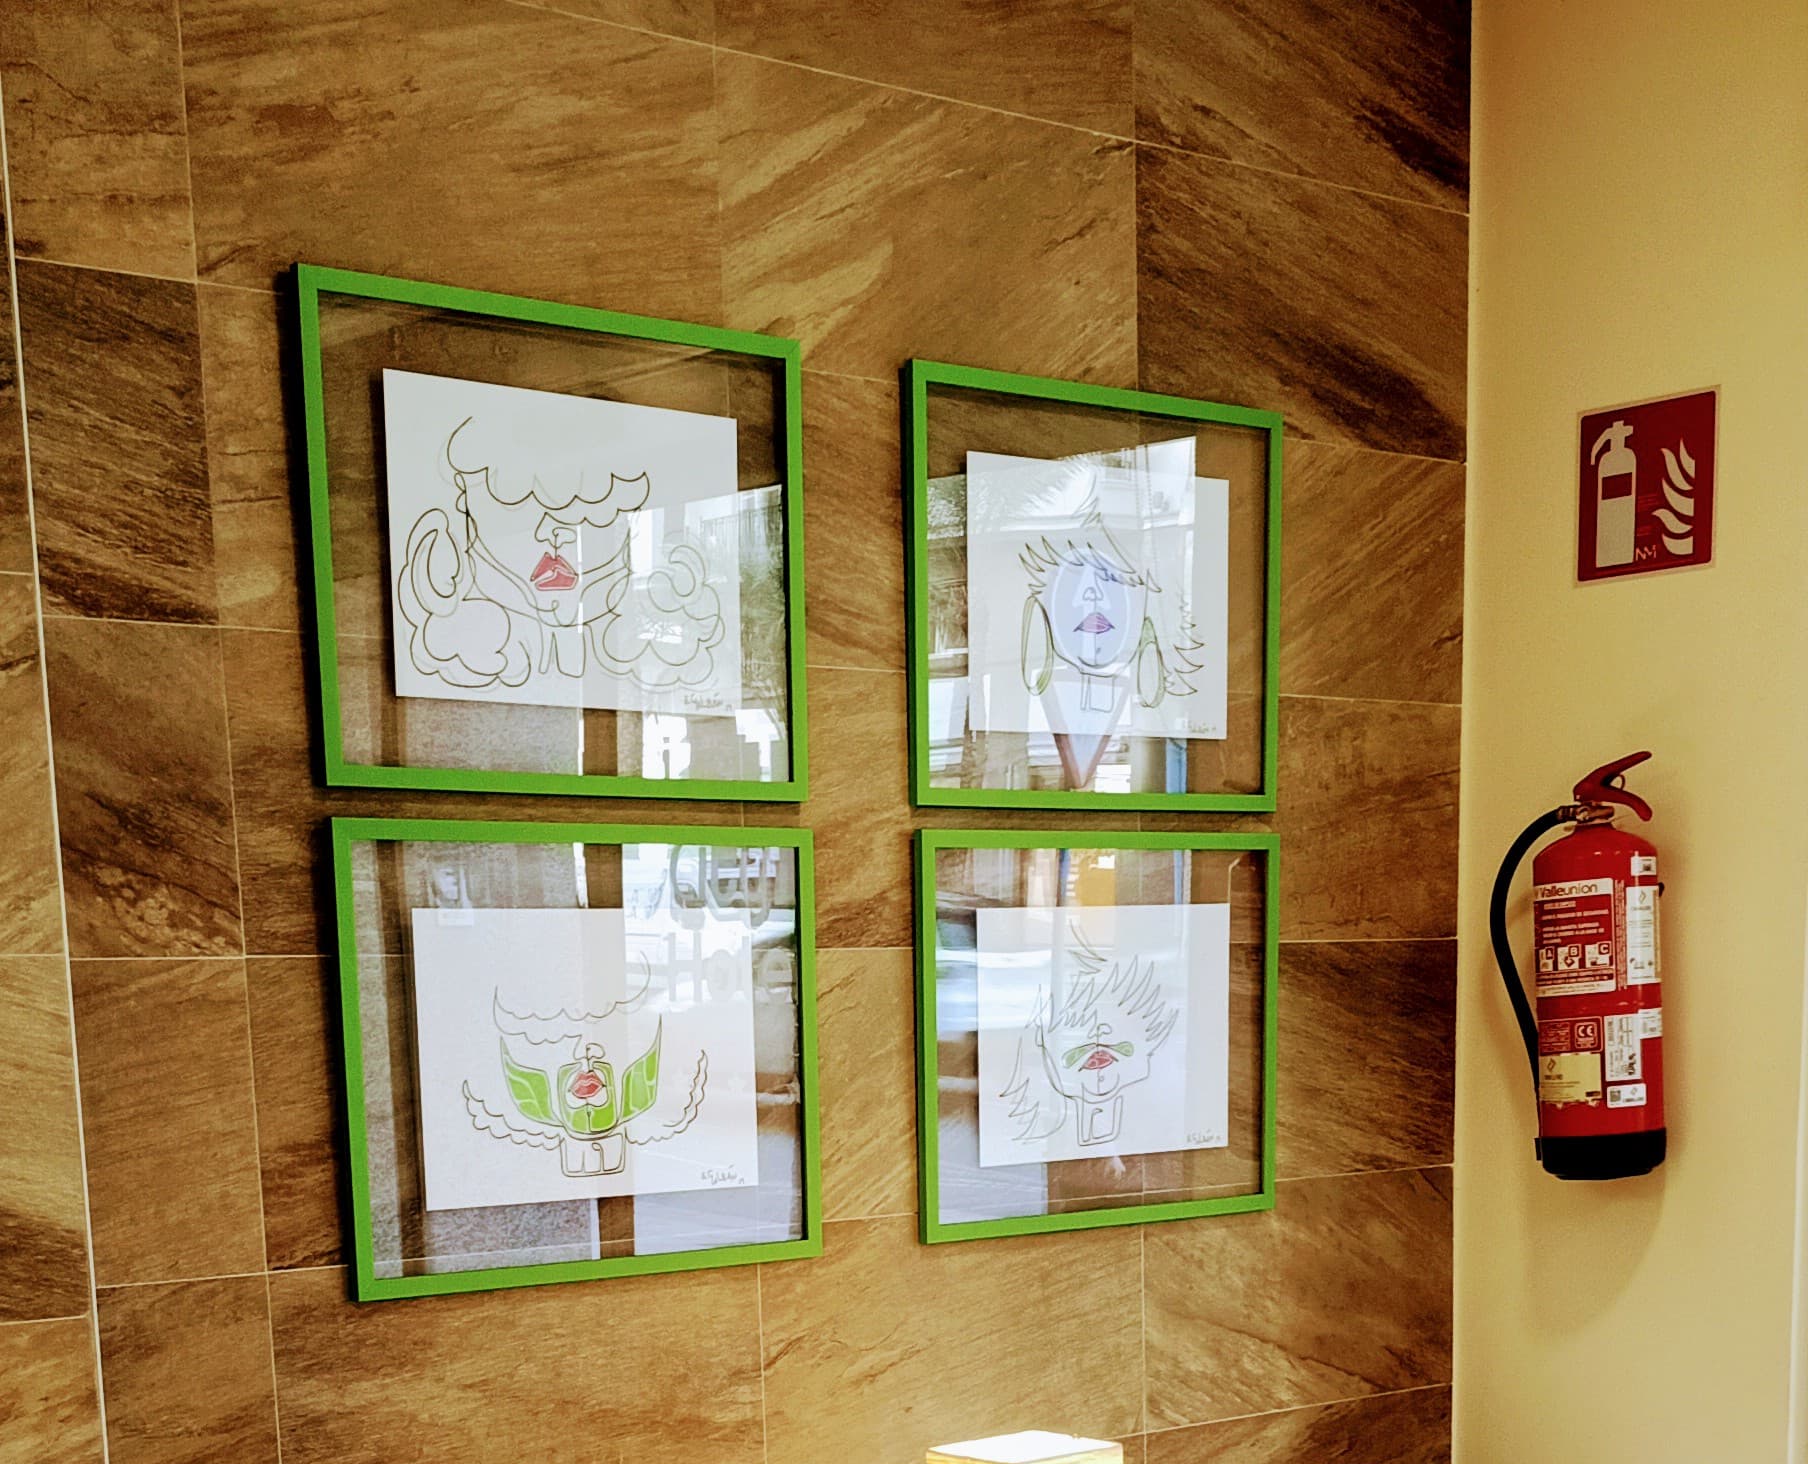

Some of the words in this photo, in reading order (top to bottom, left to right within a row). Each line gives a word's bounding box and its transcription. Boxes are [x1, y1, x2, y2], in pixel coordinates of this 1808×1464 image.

[1570, 947, 1577, 955] B
[1599, 945, 1608, 953] C
[1577, 1024, 1594, 1037] CE
